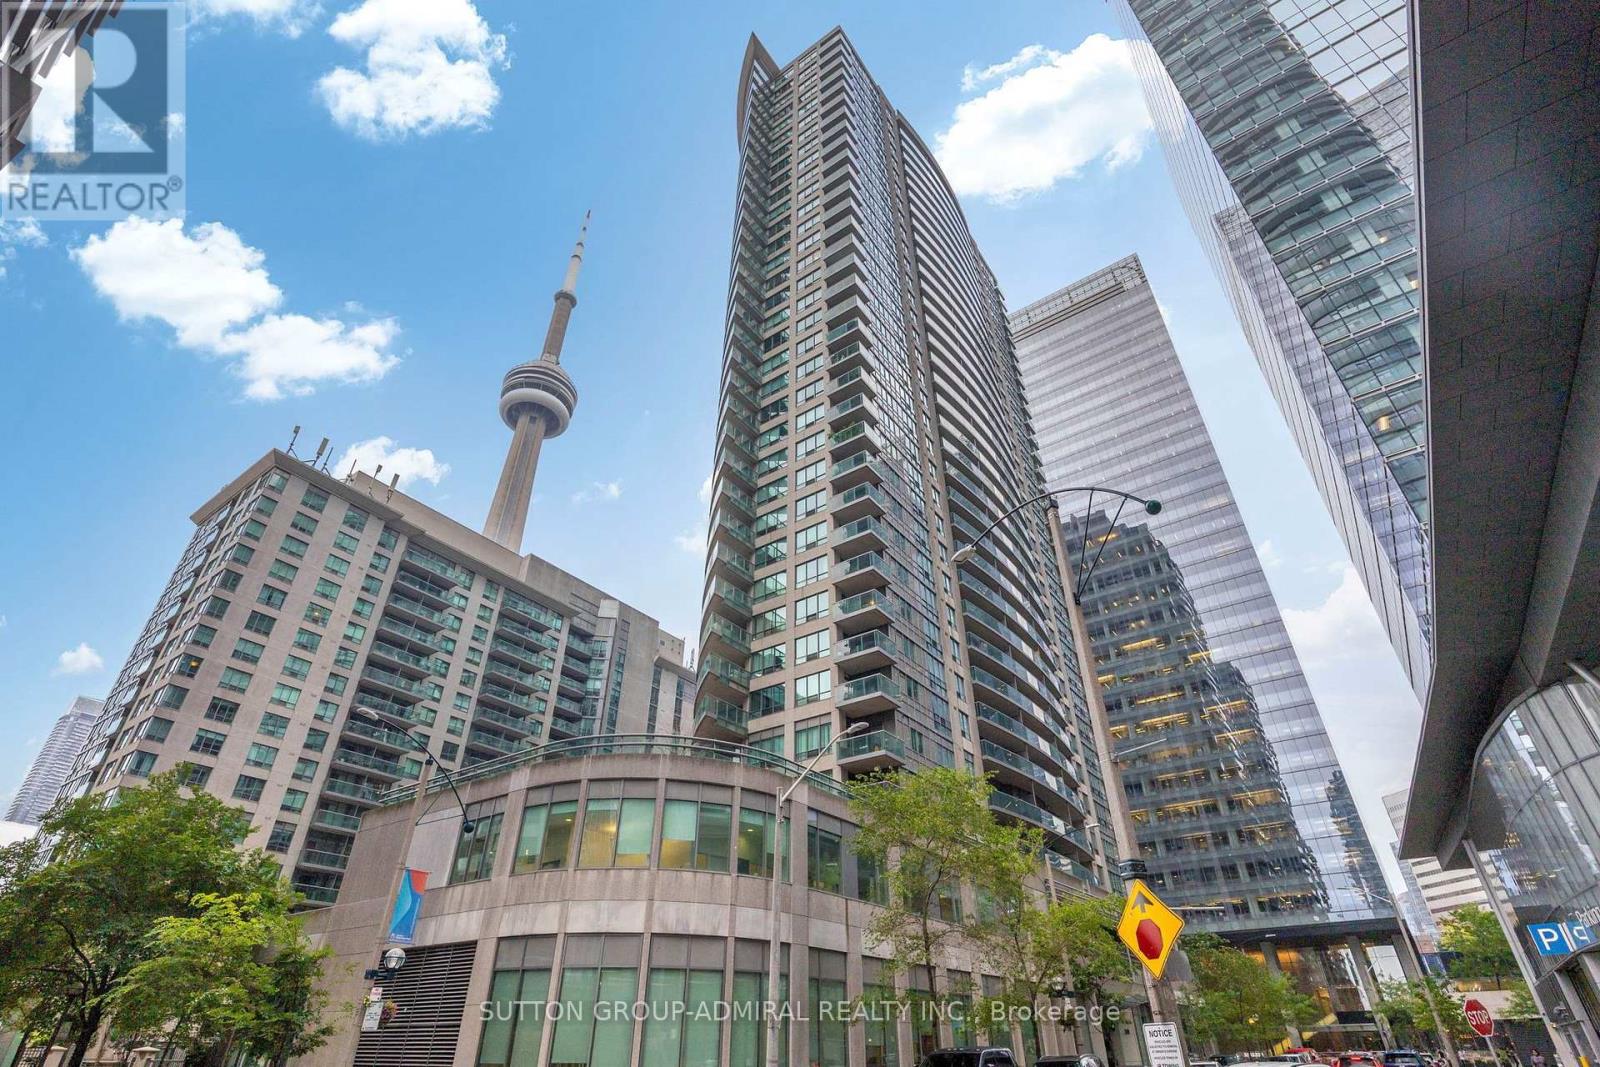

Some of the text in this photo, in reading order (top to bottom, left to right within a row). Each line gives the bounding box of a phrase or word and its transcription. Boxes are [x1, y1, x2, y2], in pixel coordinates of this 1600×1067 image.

[1537, 928, 1558, 950] P
[1467, 1010, 1490, 1025] STOP
[1148, 1029, 1173, 1038] NOTICE
